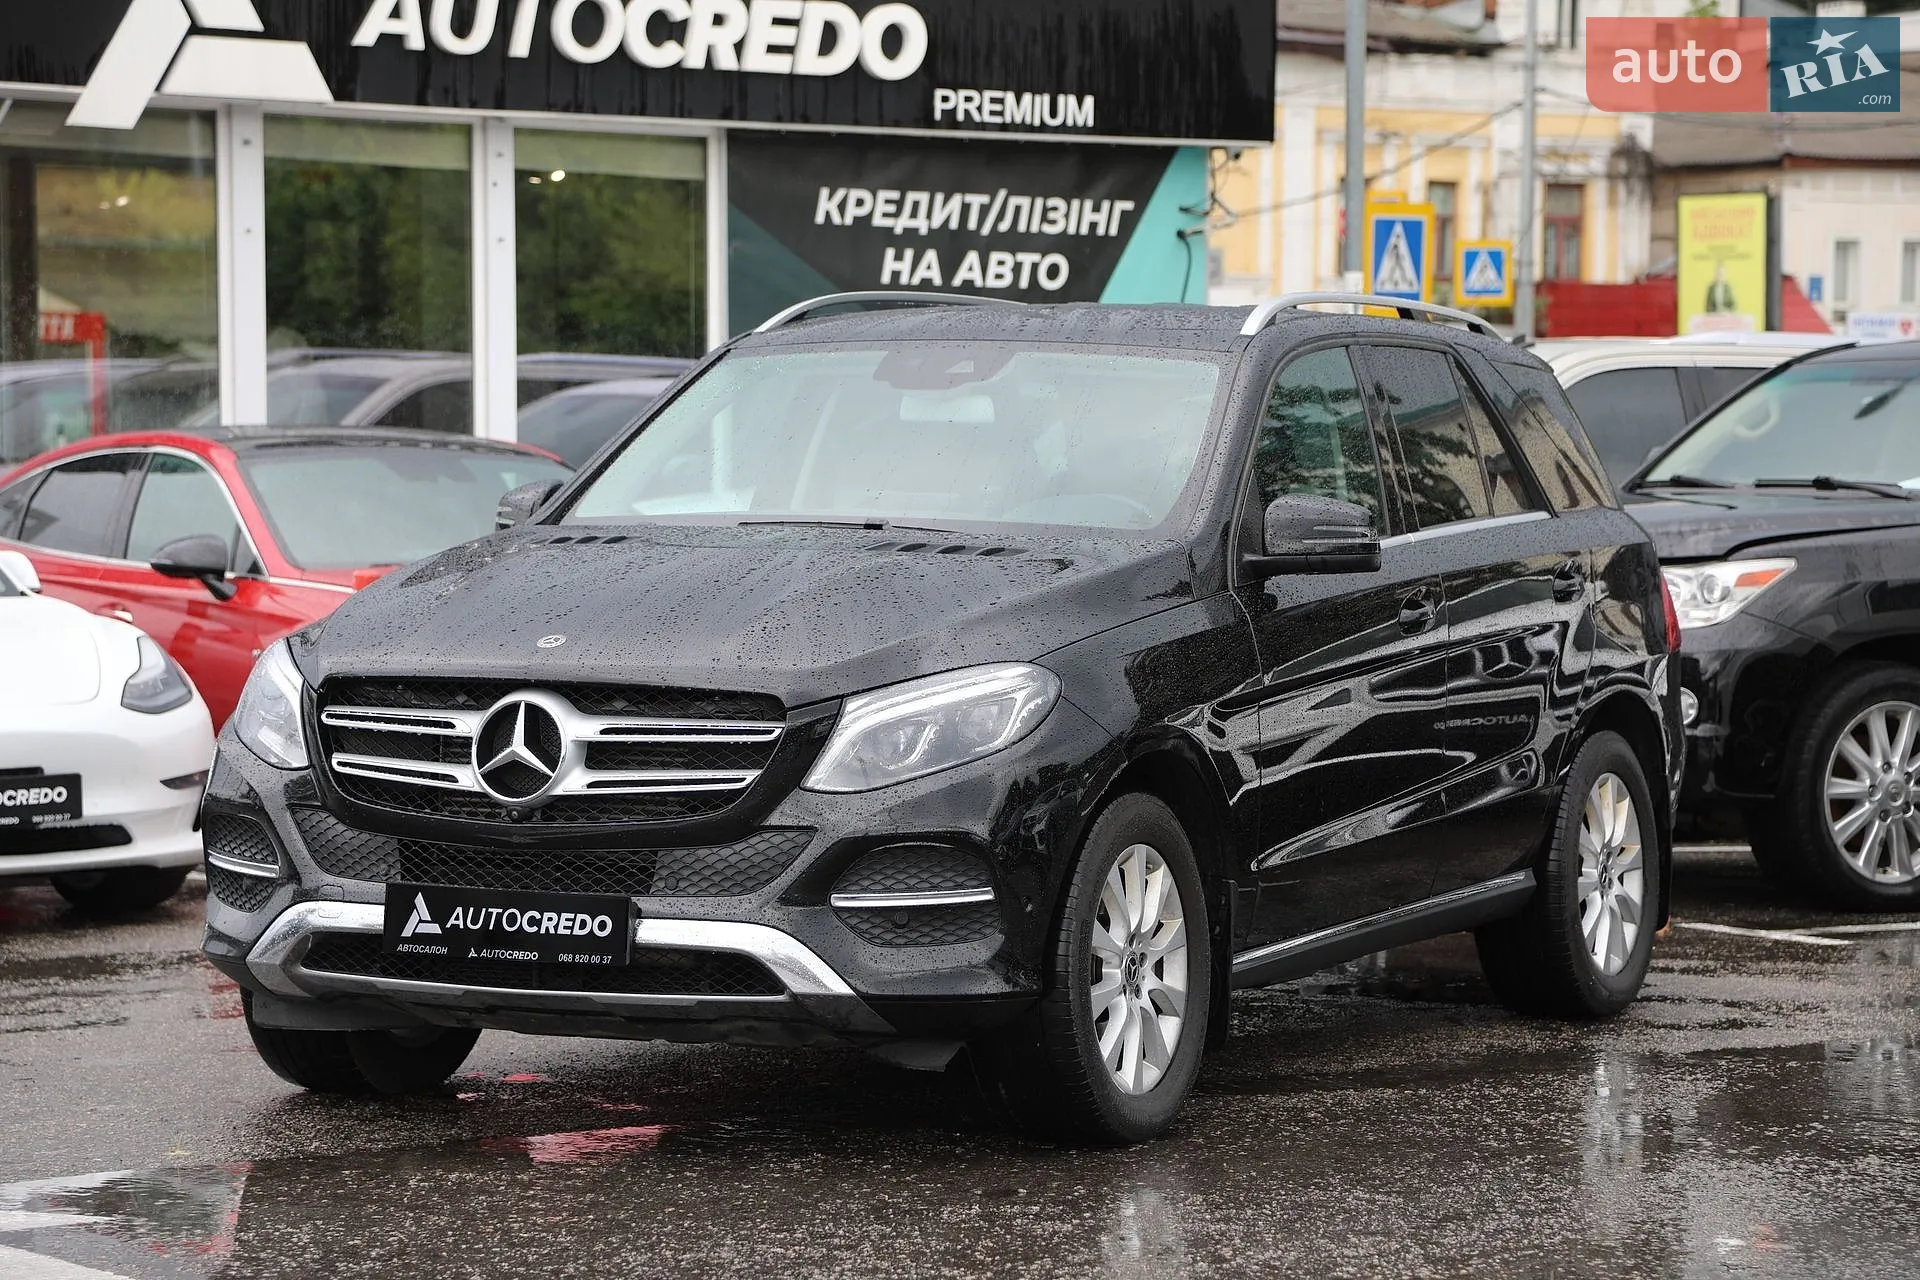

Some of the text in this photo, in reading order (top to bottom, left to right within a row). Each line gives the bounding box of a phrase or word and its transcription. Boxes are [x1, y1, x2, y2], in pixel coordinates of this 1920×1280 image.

[350, 0, 929, 81] AUTOCREDO
[933, 87, 1095, 128] PREMIUM
[814, 185, 1135, 237] КРЕДИТ/ЛІЗІНГ
[880, 246, 1070, 291] НА АВТО
[0, 786, 68, 807] CREDO
[446, 906, 613, 937] AUTOCREDO
[396, 943, 448, 955] АВТОСАЛОН
[480, 948, 538, 961] AUTOCREDO
[558, 953, 612, 965] 068 820 00 37
